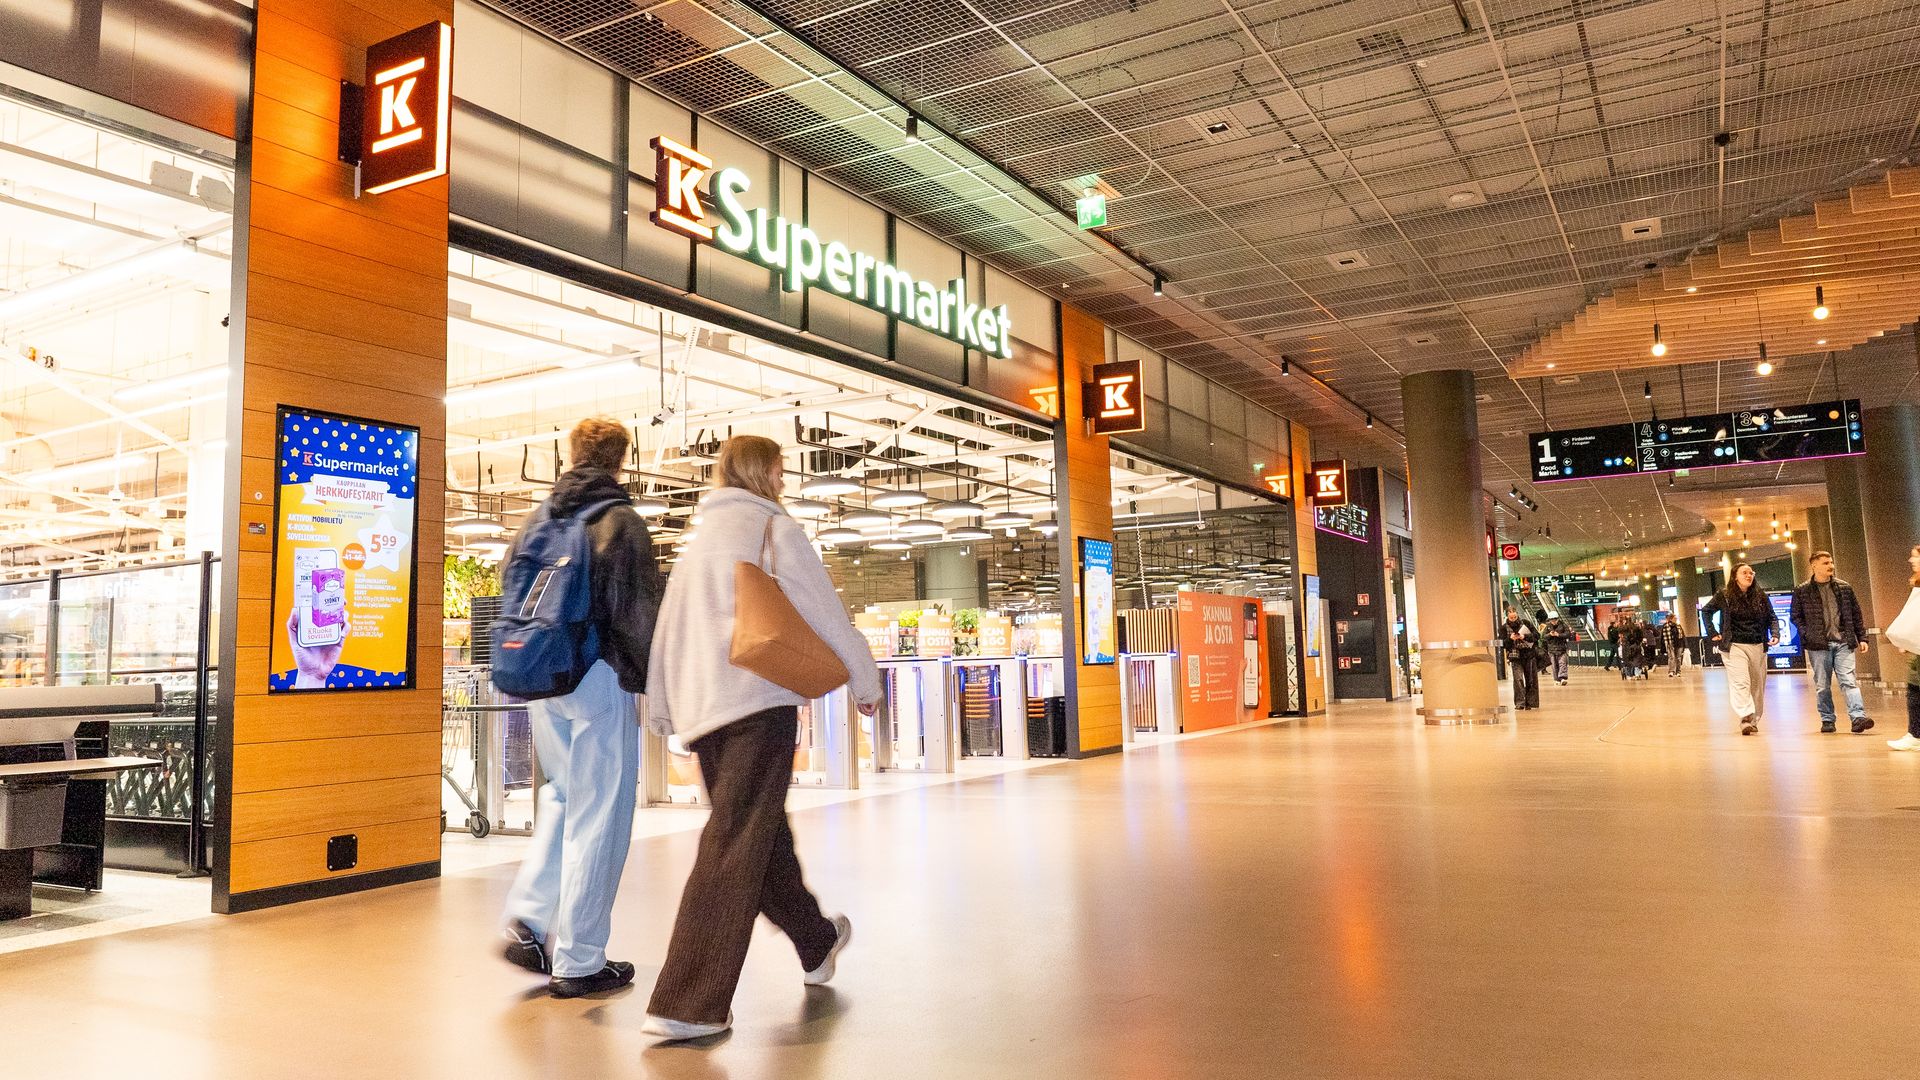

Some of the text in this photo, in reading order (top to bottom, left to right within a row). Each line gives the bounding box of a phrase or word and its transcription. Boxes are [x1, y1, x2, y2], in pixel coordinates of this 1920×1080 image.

[712, 167, 1013, 359] Supermarket
[1740, 412, 1753, 426] 3
[1641, 424, 1653, 437] 4
[1538, 438, 1556, 463] 1
[1643, 448, 1655, 462] 2
[314, 454, 399, 477] Supermarket
[315, 485, 385, 502] HERKKUFESTARIT
[1202, 605, 1232, 622] SKANNAA
[1204, 624, 1233, 644] JA OSTA
